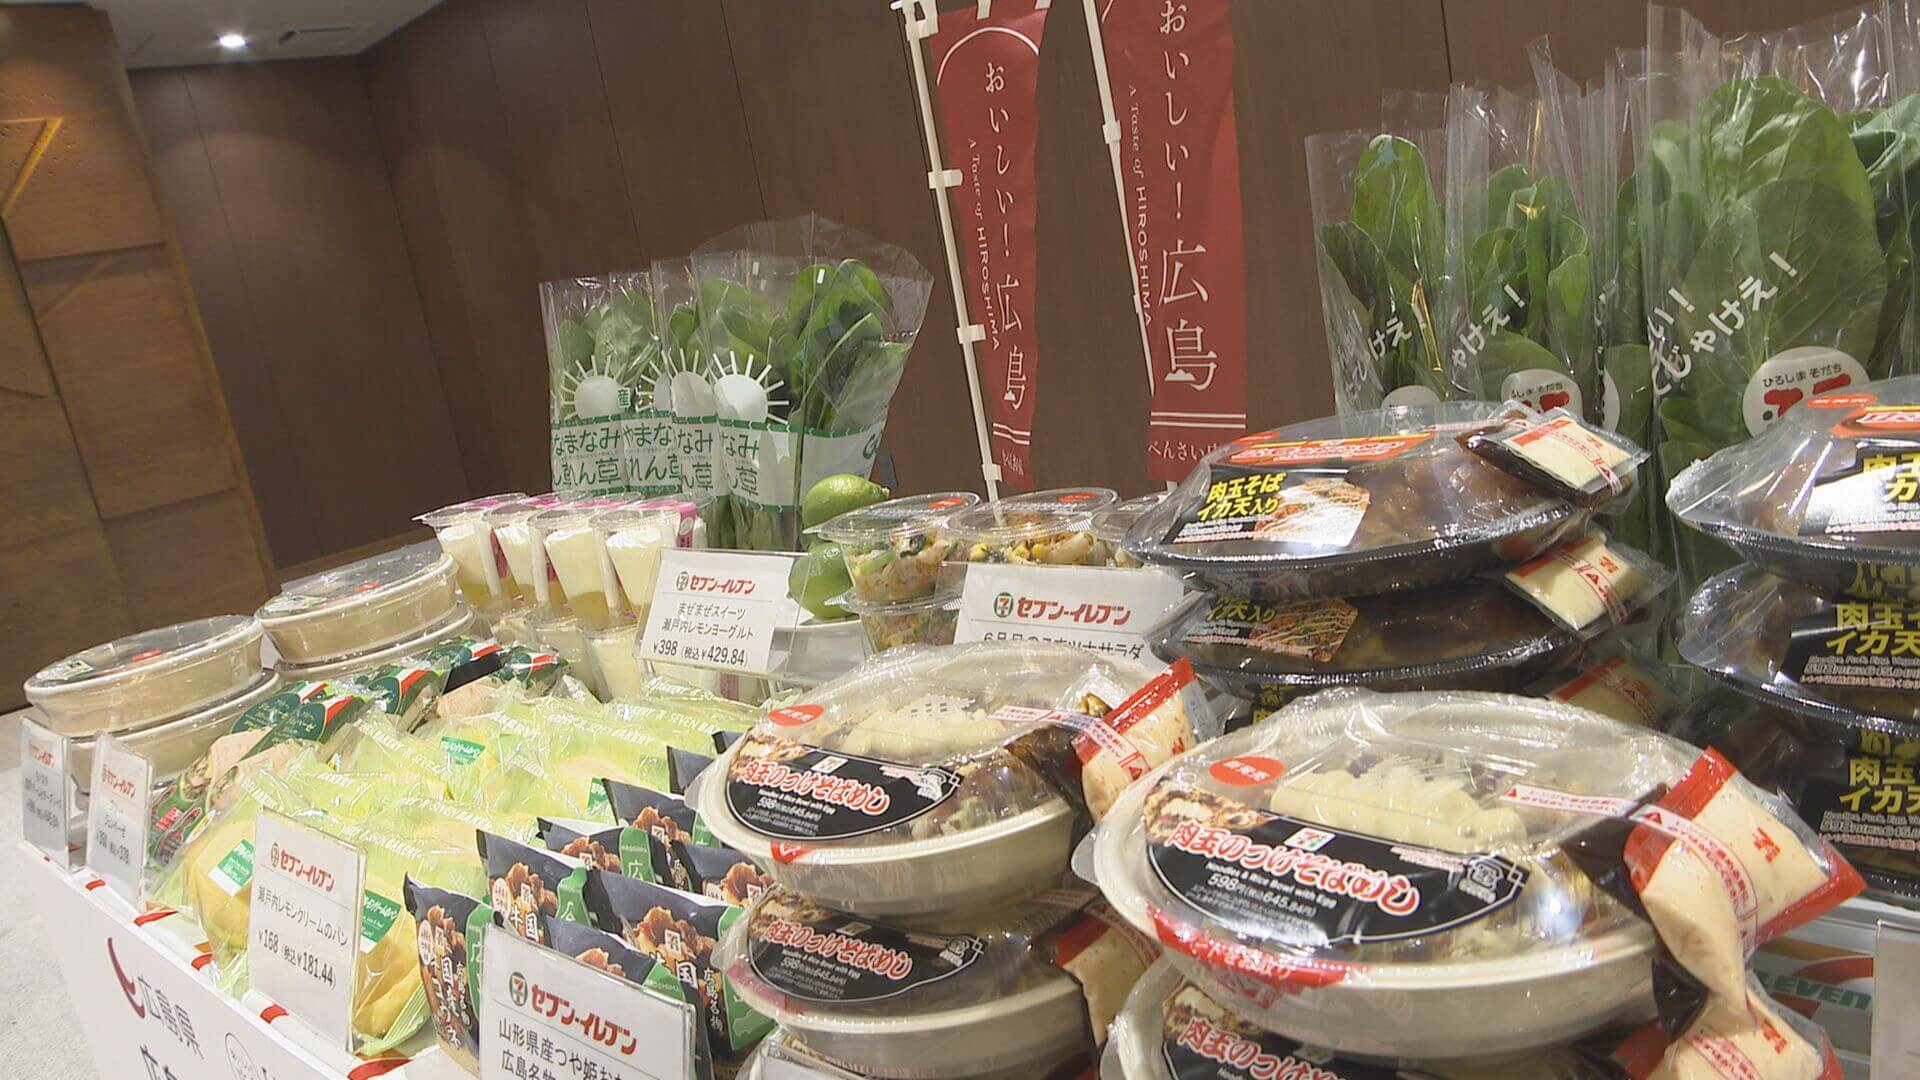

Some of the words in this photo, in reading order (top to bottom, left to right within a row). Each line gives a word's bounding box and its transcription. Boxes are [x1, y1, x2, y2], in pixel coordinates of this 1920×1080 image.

[1130, 103, 1140, 152] Taste
[1133, 157, 1145, 178] of
[1158, 0, 1218, 391] おいしい！広島
[984, 62, 1027, 410] おいしい！広島
[1136, 185, 1153, 327] HIROSHIMA
[976, 227, 1000, 351] HIROSHIMA
[1206, 472, 1287, 504] 肉玉そば
[1197, 495, 1280, 521] イカ天入り
[689, 574, 756, 595] セブン-イレブン
[677, 602, 746, 621] まぜまぜスイーツ
[1016, 597, 1132, 626] セブン-イレブン
[661, 617, 754, 640] 瀬戸内レモンヨーグルト
[653, 639, 679, 657] ¥398
[280, 849, 335, 893] セブン-イレブン
[531, 983, 638, 1055] セブン-イレブン
